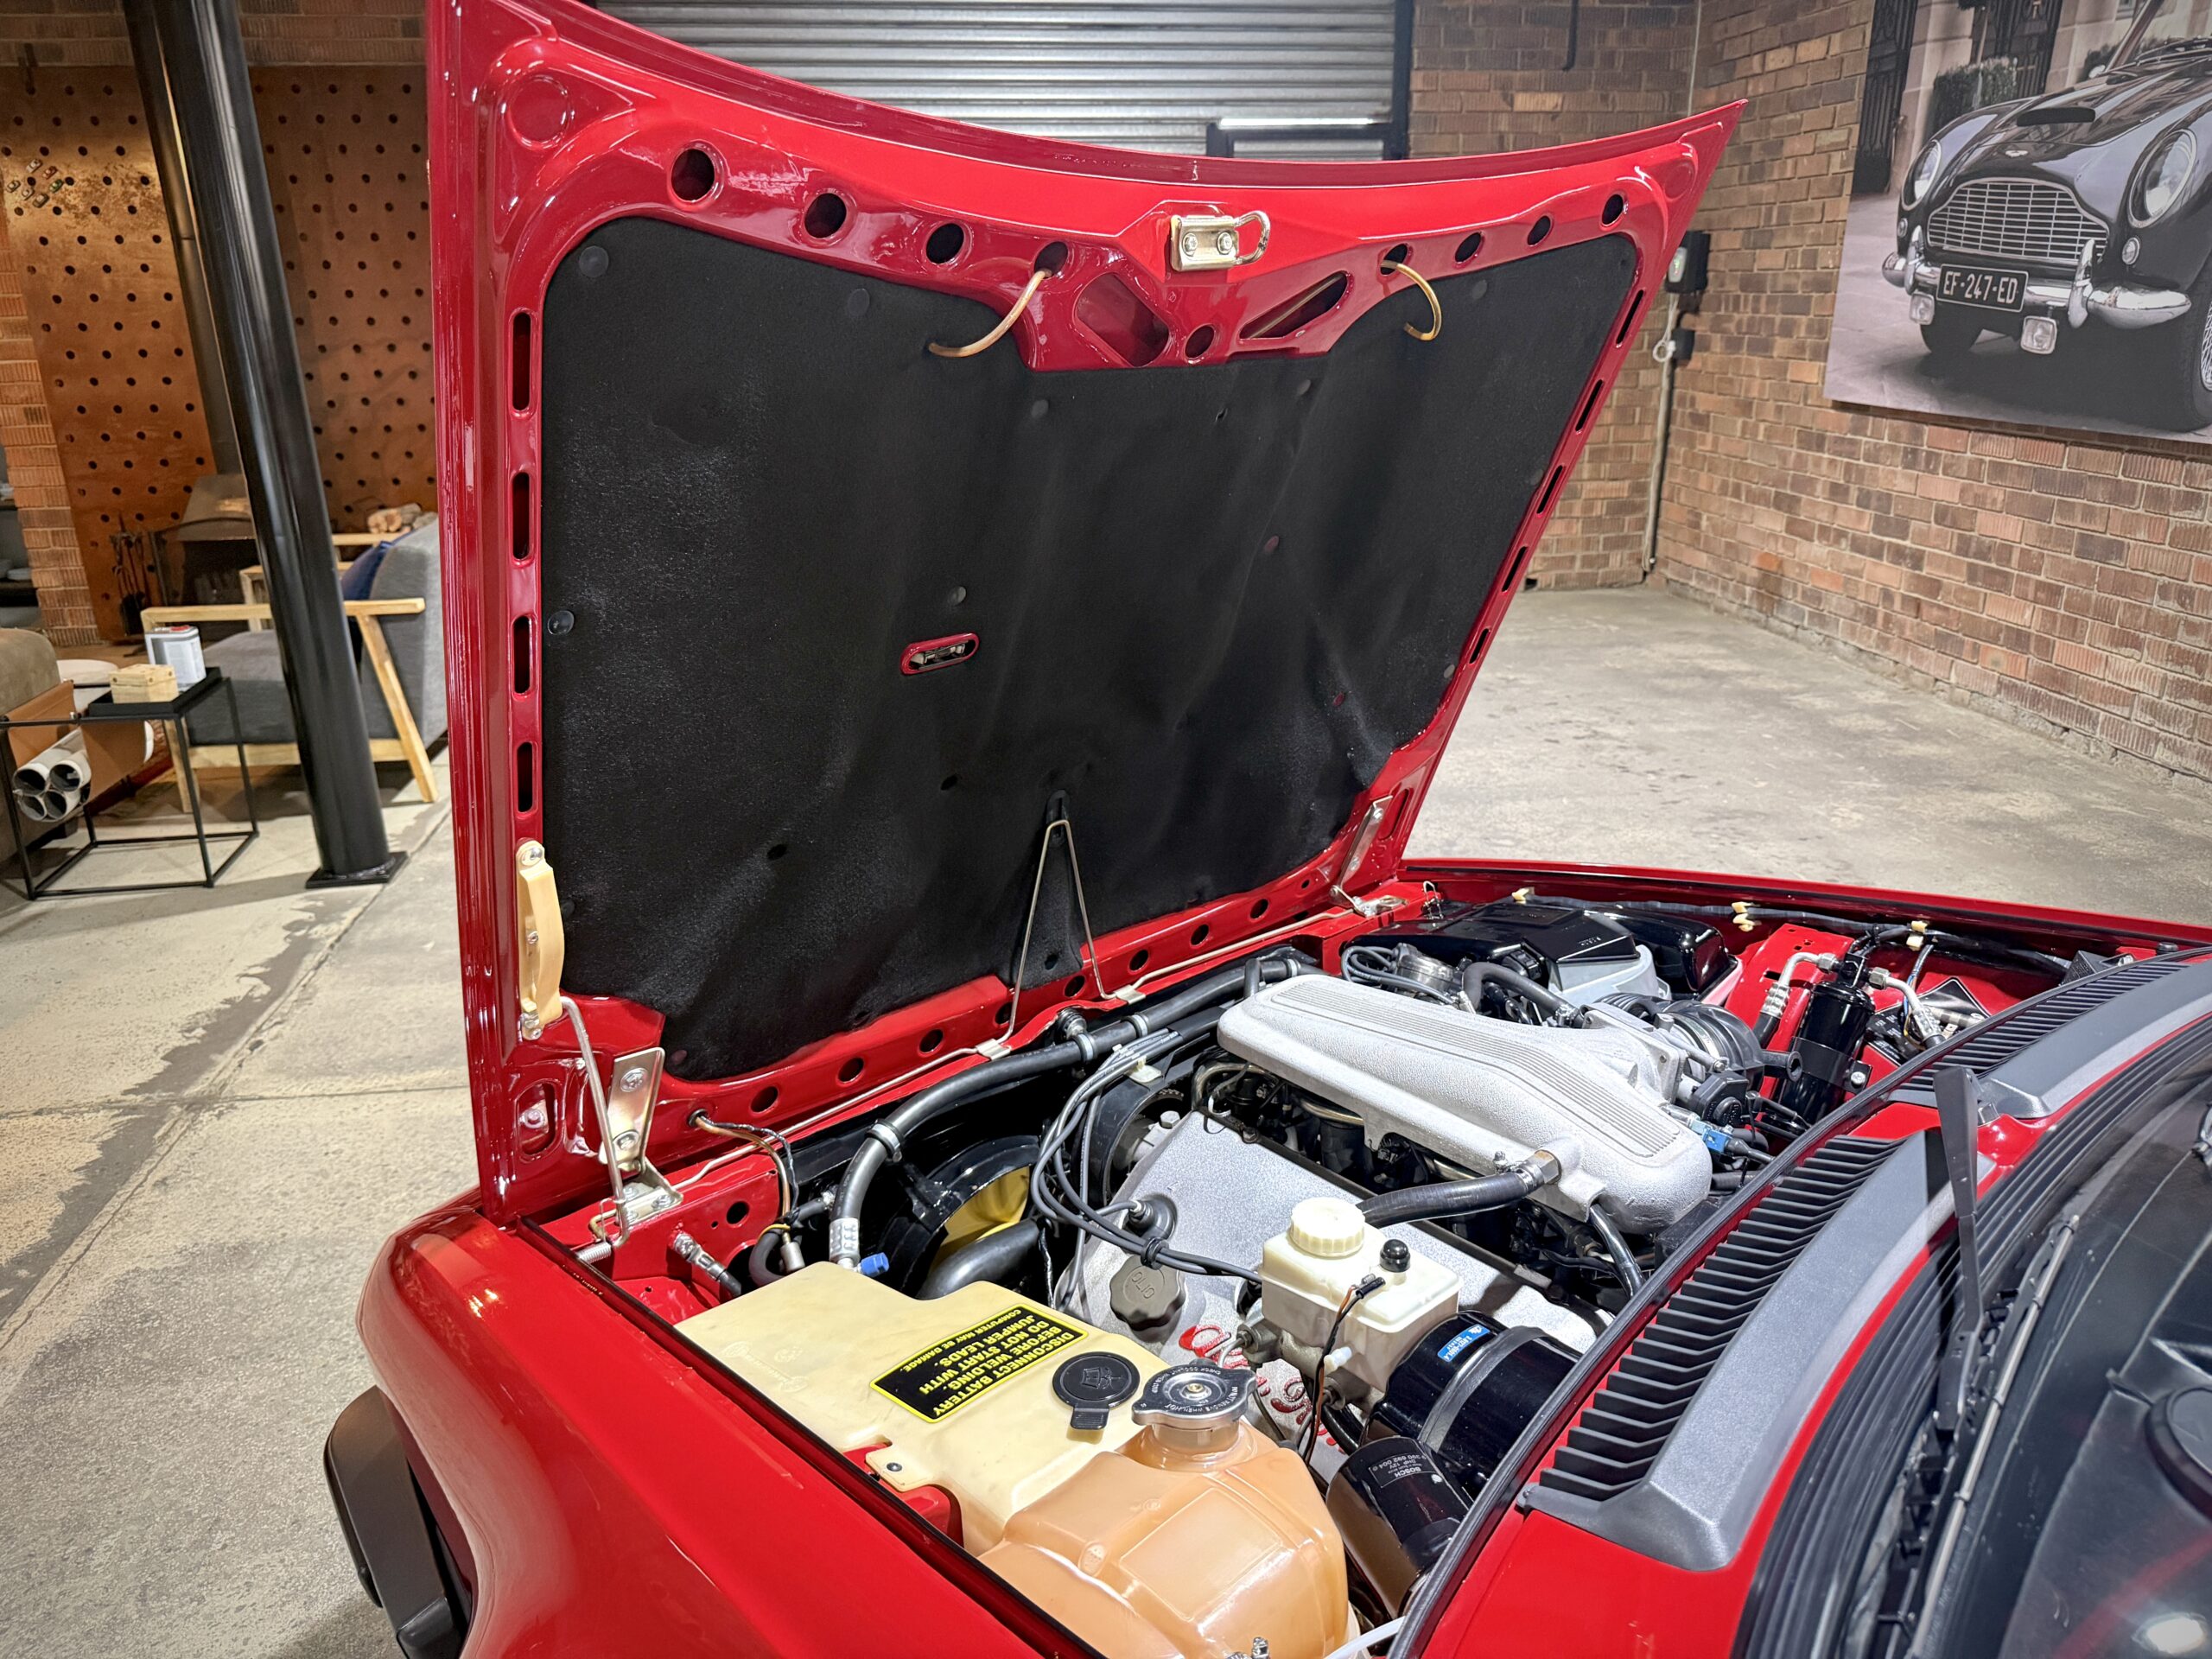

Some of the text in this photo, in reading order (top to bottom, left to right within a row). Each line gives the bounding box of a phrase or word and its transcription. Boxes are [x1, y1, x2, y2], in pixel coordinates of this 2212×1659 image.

[1131, 1271, 1155, 1299] OLIO
[899, 1309, 1022, 1373] COMPUTER MAY BE DAMAGE.
[919, 1320, 1050, 1395] DO NOT START WITH
[934, 1314, 1035, 1367] JUMPER LEADS.
[943, 1326, 1062, 1390] BEFORE WELDING.
[932, 1332, 1075, 1416] DISCONNECT BATTERY
[1394, 1466, 1421, 1478] BOSCH
